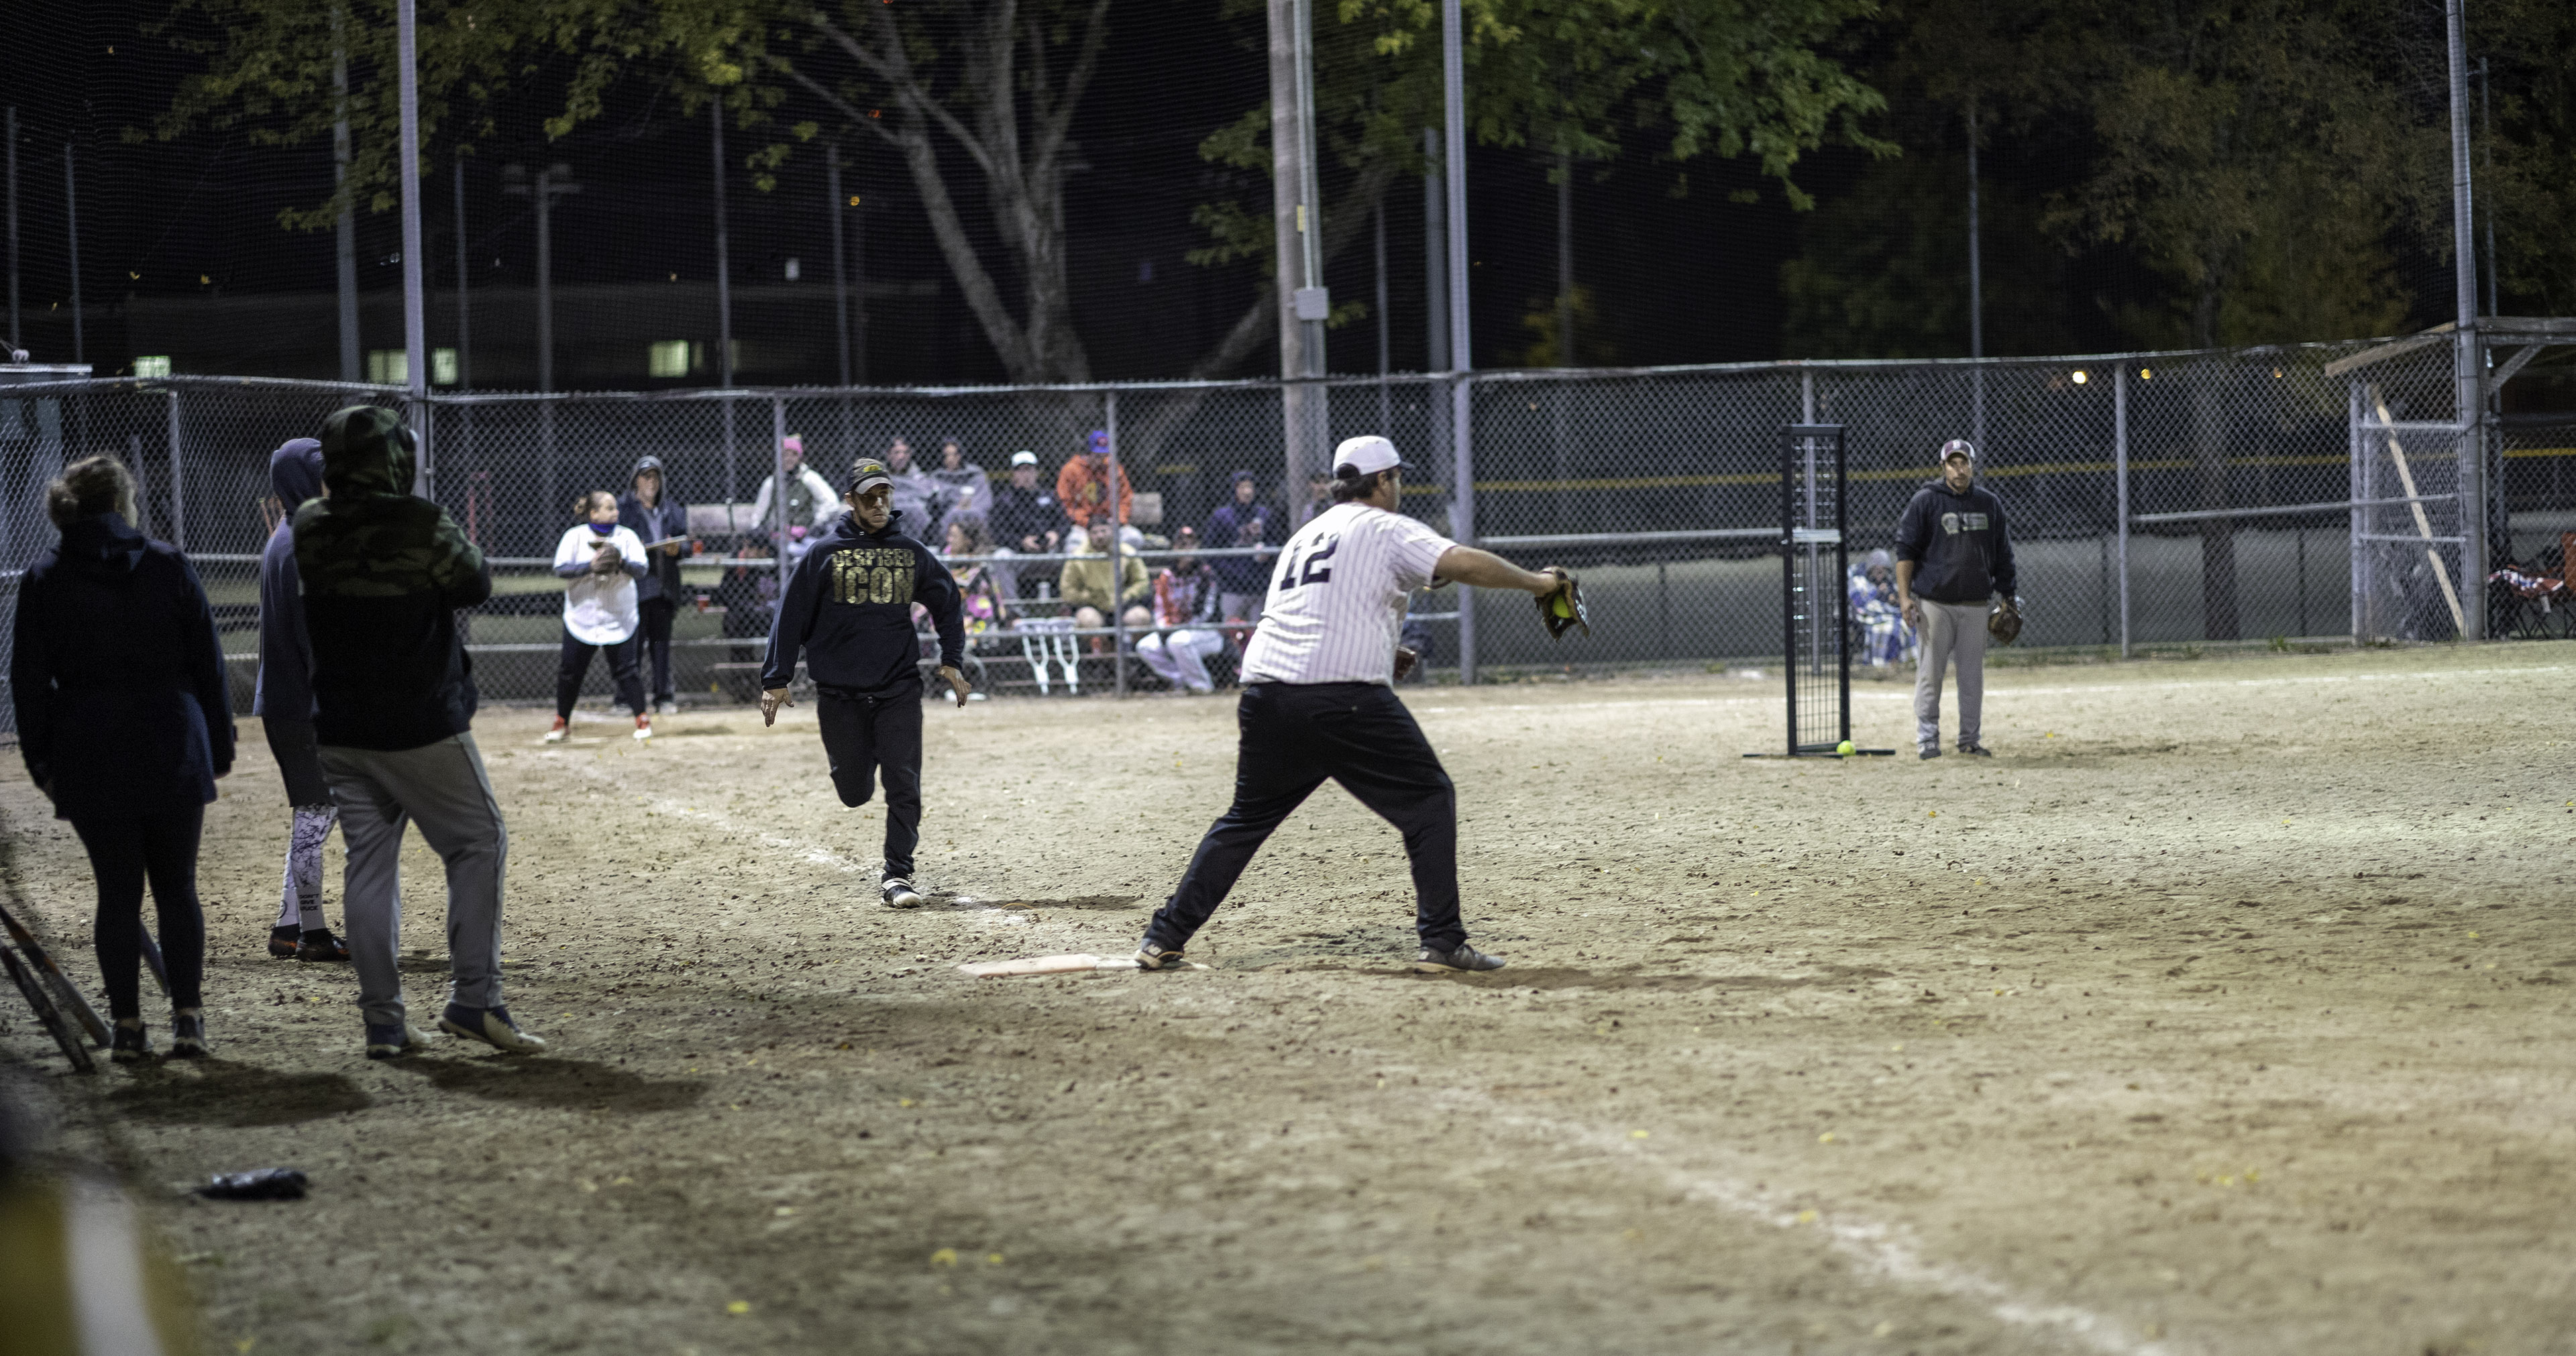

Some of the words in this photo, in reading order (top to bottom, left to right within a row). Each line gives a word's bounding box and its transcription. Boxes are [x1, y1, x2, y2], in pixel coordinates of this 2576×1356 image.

[832, 548, 916, 567] DESPISED
[1281, 532, 1340, 590] 12
[832, 567, 915, 604] ICON
